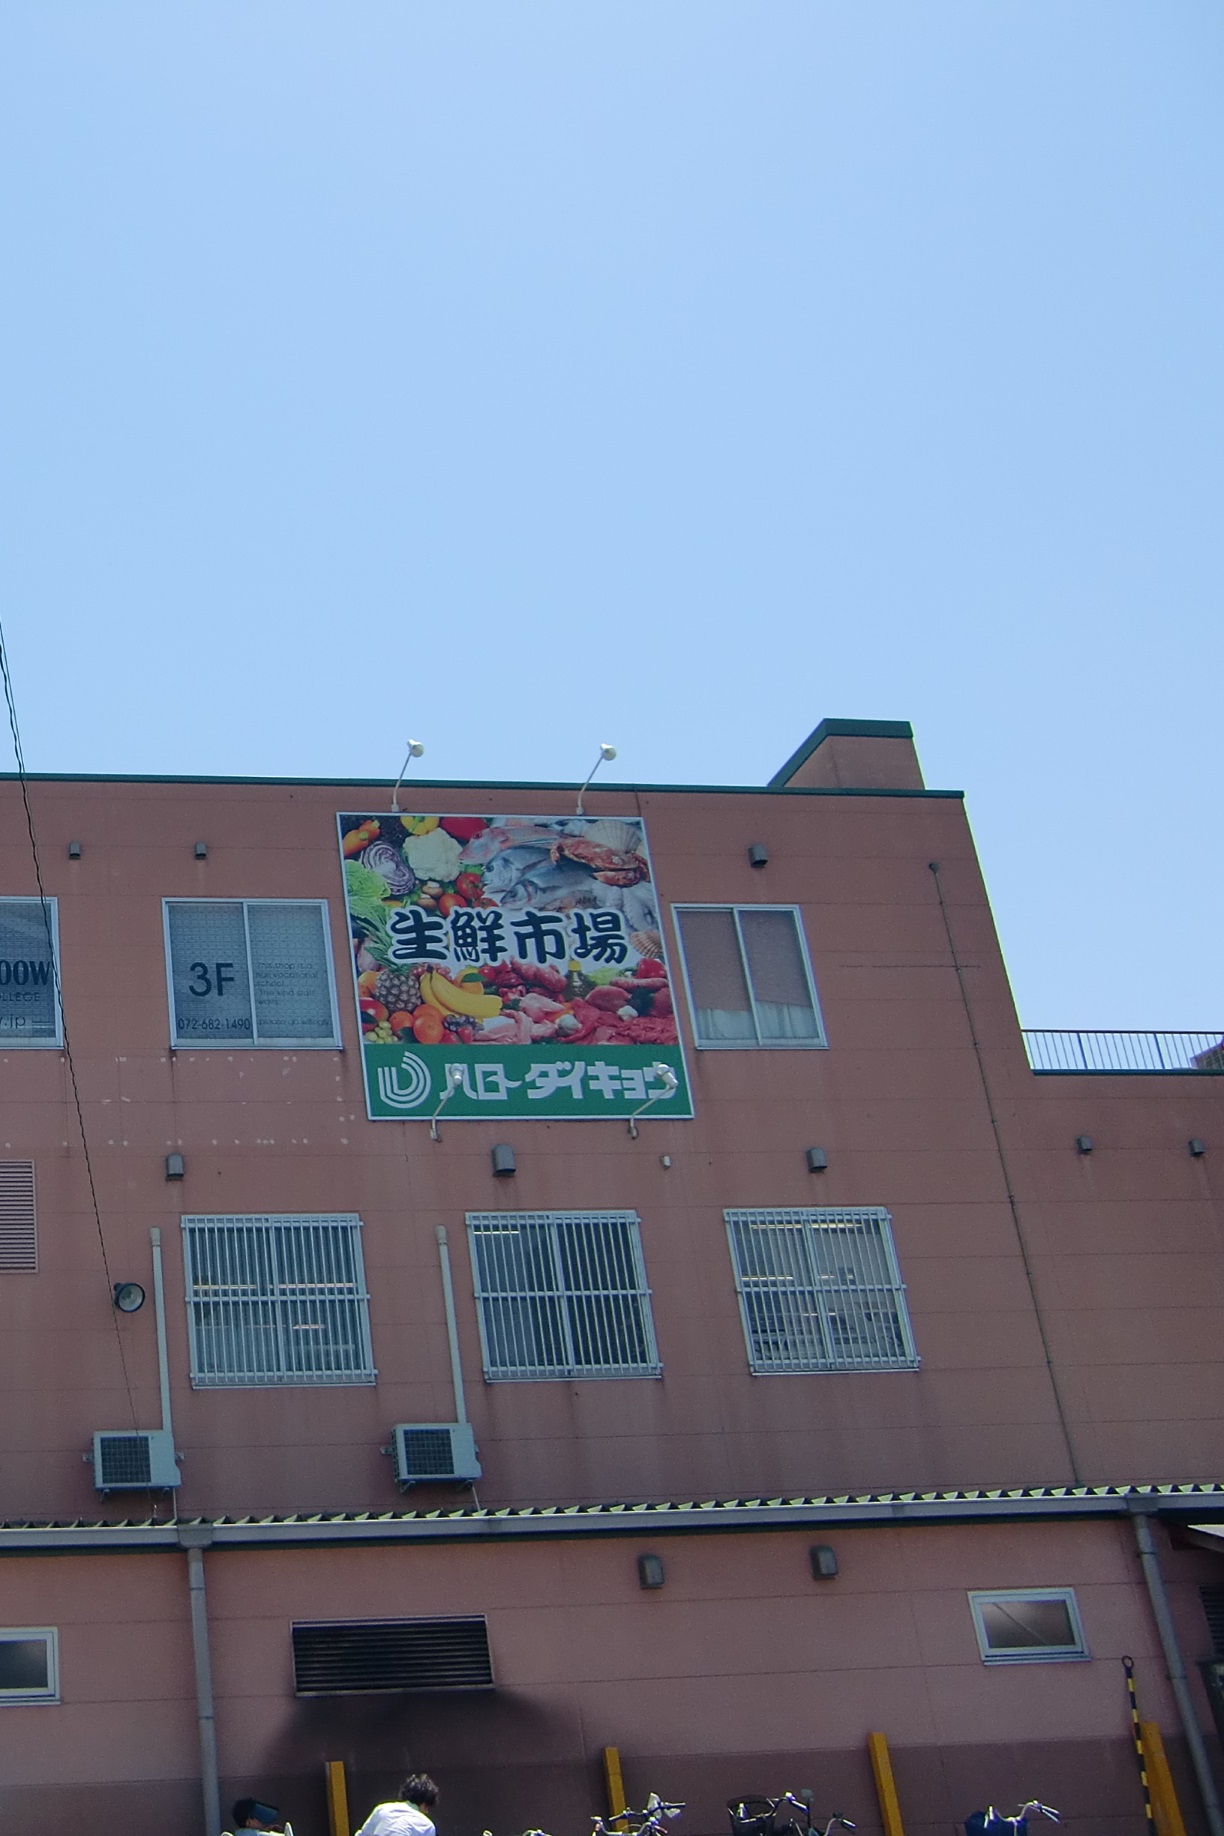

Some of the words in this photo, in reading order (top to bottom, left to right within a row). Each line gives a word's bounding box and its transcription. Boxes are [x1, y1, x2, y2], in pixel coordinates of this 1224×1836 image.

[389, 908, 630, 965] 生鮮市場
[188, 961, 235, 997] 3F
[178, 1018, 251, 1030] 072-682-1490
